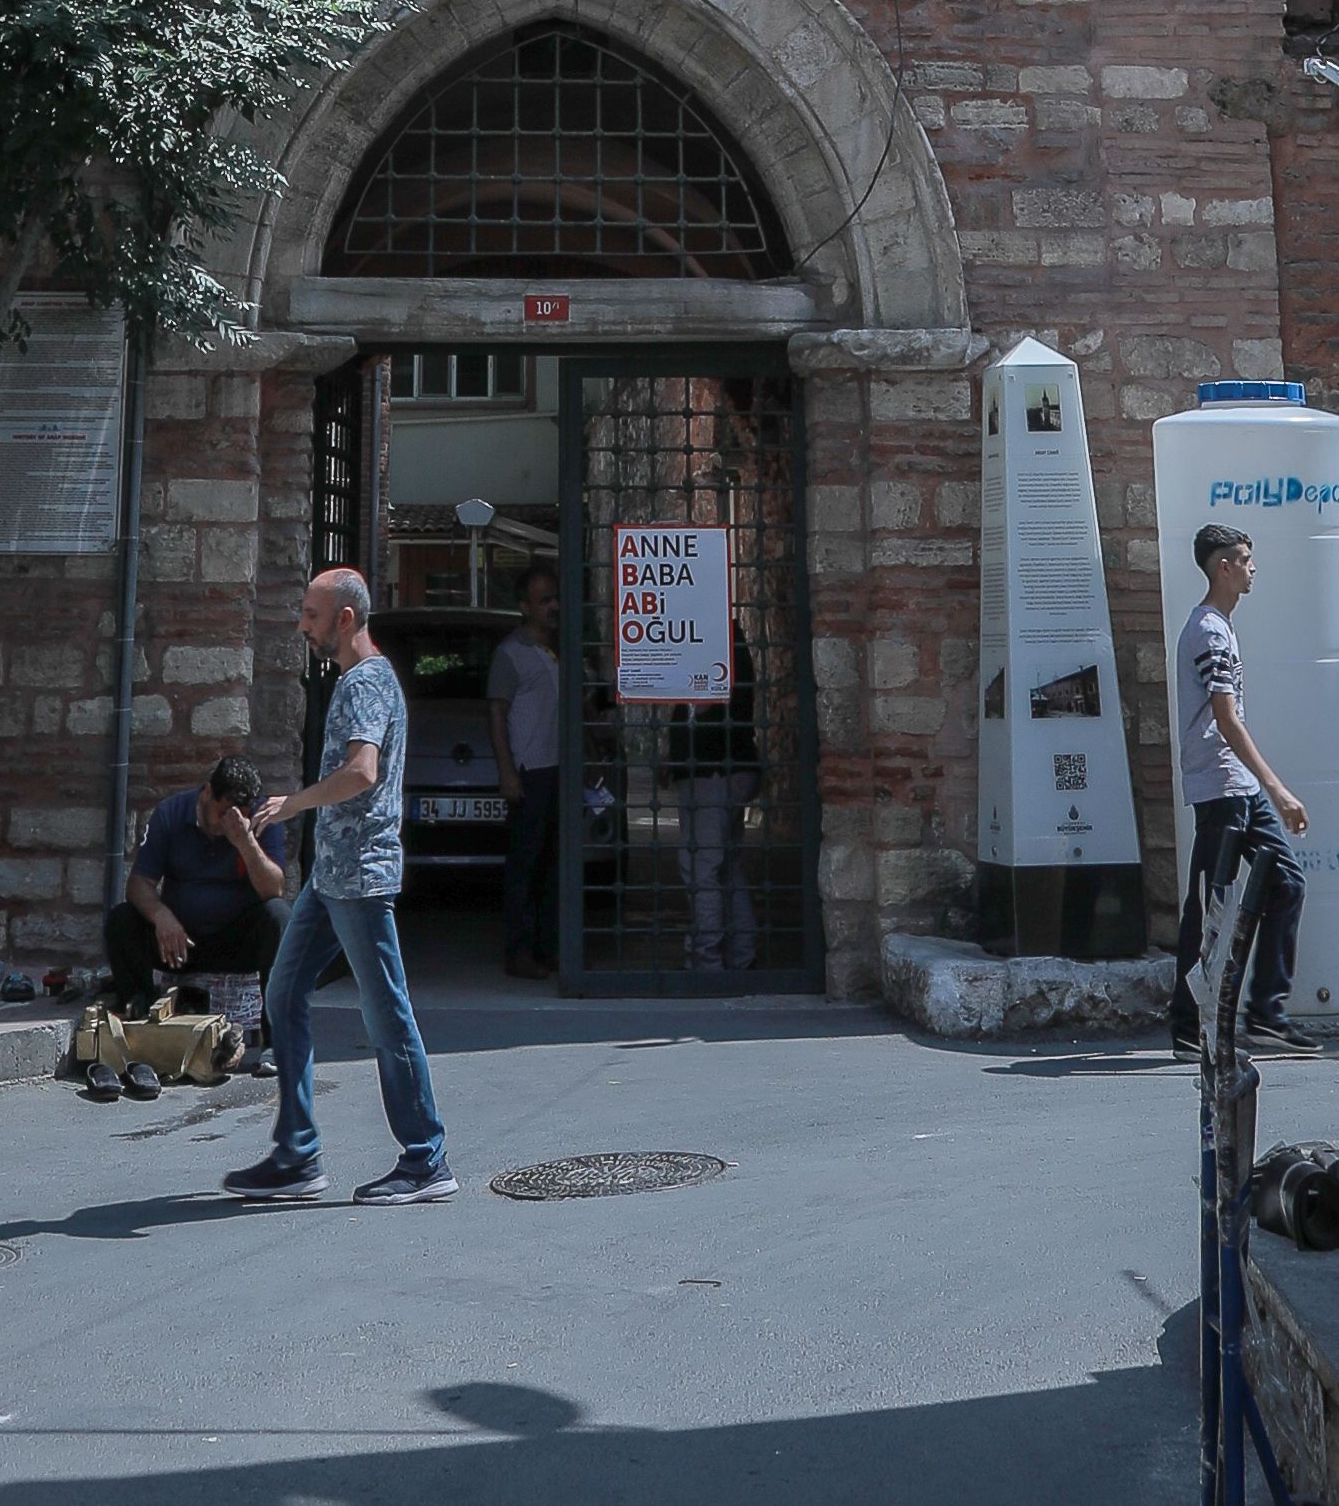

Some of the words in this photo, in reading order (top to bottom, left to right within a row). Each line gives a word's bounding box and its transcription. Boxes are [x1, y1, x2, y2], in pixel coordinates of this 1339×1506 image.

[620, 535, 699, 558] ANNE
[622, 563, 695, 586] BABA
[622, 616, 704, 644] OĞUL
[421, 800, 439, 818] 34
[448, 800, 466, 818] JJ
[474, 800, 508, 818] 595
